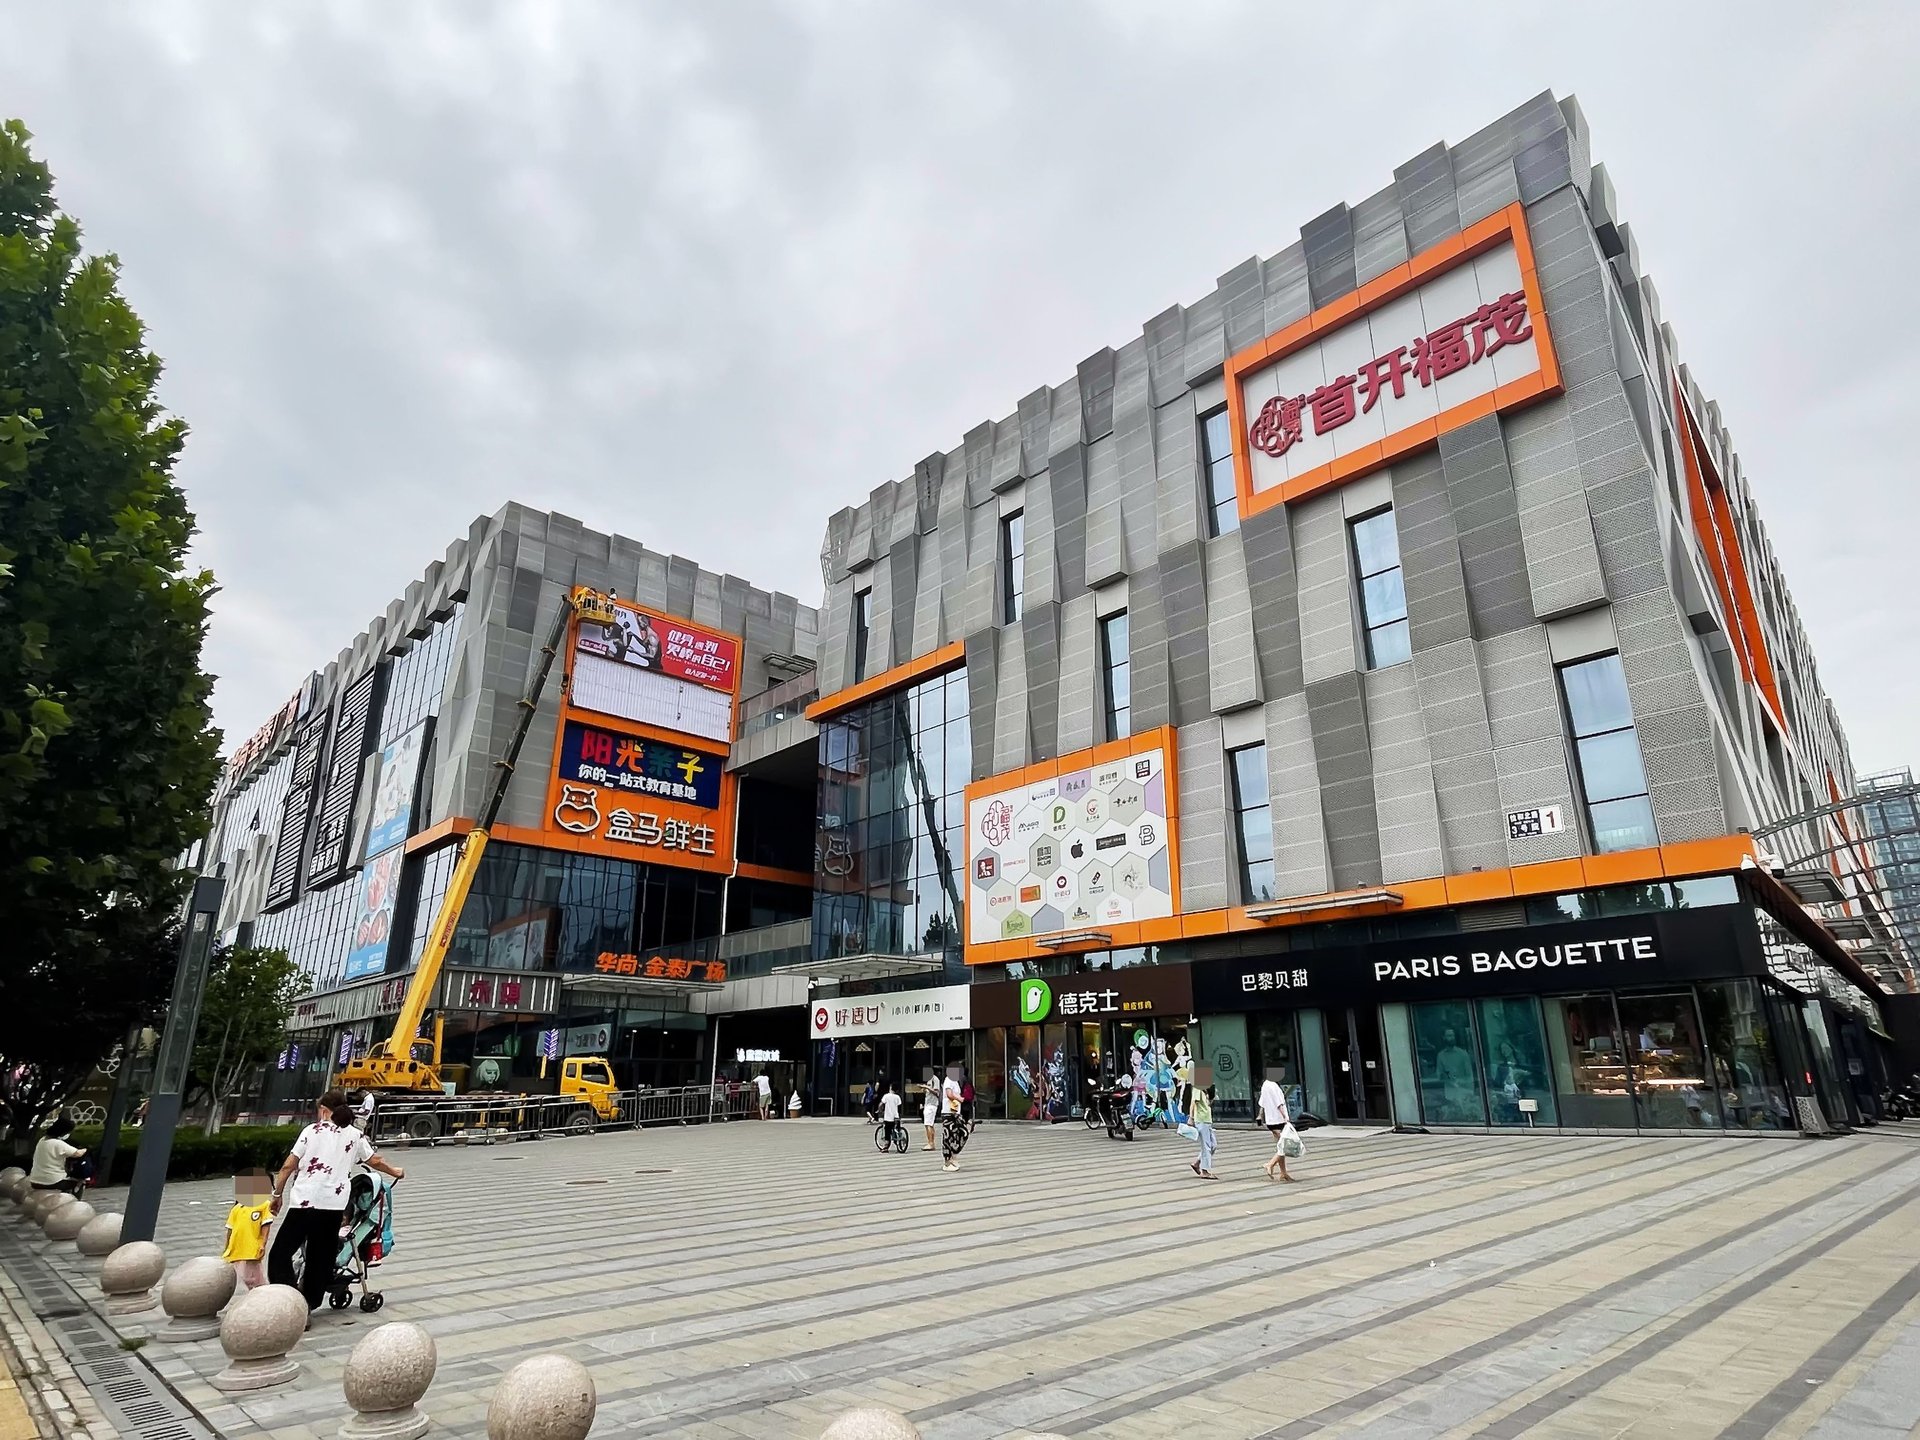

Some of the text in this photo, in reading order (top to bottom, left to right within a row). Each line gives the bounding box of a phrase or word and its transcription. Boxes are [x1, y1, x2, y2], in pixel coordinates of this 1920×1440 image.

[1307, 290, 1533, 436] 首开福茂
[578, 763, 697, 800] 你的一站式教育基地
[604, 807, 716, 854] 盒马鲜生
[1546, 810, 1556, 828] 1
[1374, 936, 1658, 982] PARIS BAGUETTE
[1241, 969, 1309, 992] 巴黎贝甜
[1058, 988, 1120, 1016] 德克士
